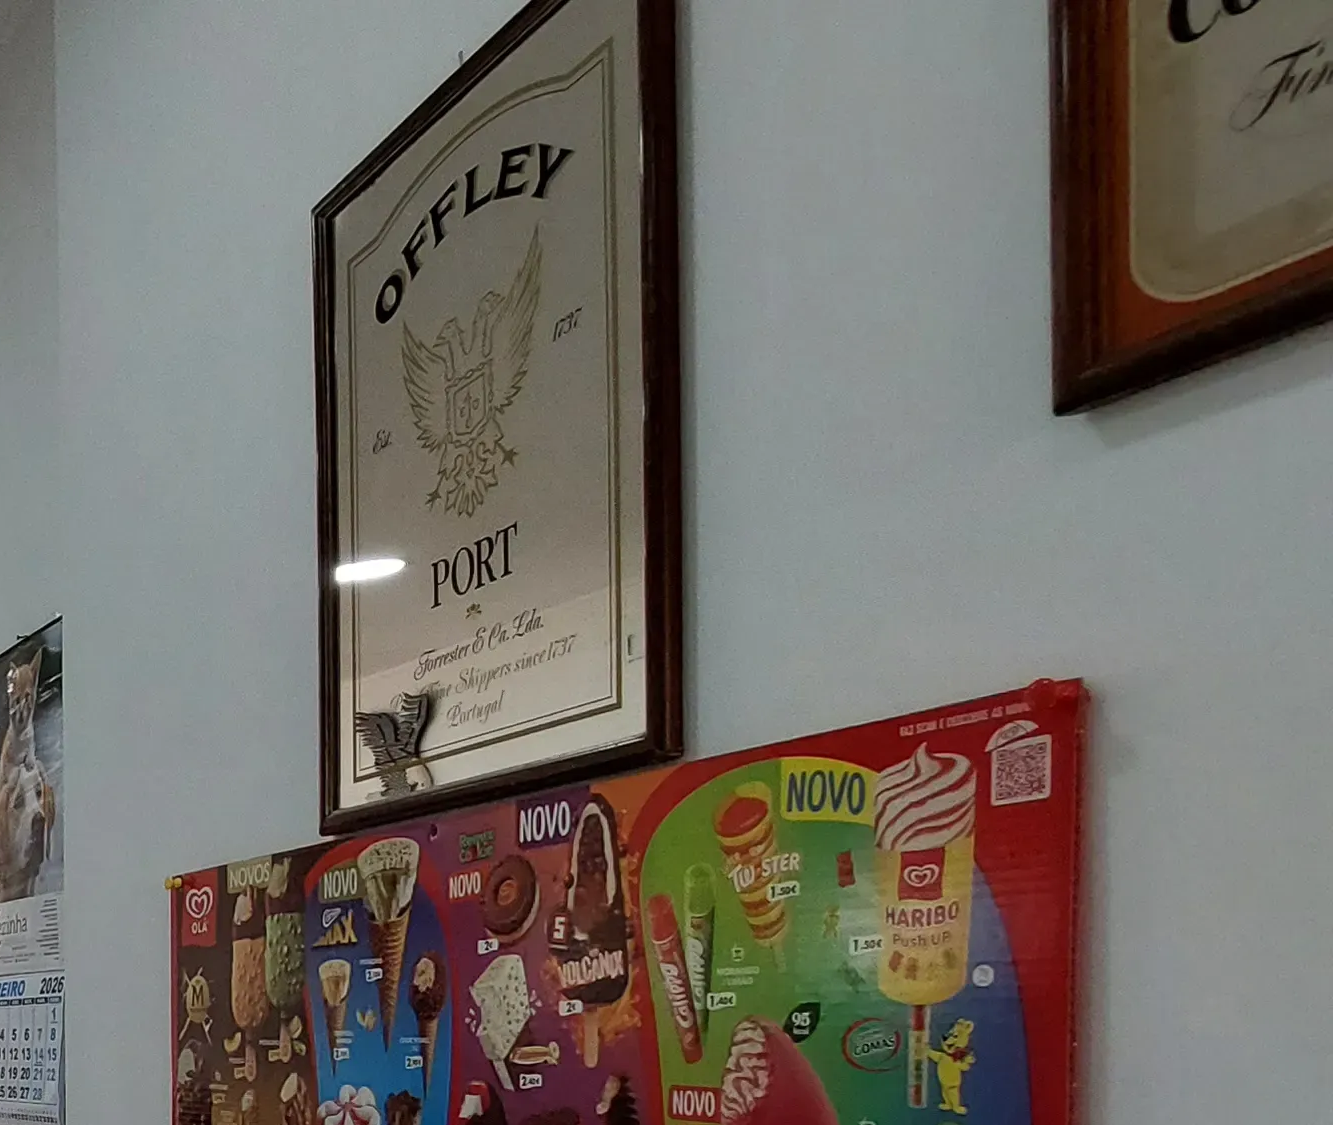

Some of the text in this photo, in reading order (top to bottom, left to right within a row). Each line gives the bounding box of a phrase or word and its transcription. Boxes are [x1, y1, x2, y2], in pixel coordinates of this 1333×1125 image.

[376, 143, 574, 325] OFFLEY
[552, 306, 583, 342] 1737
[431, 521, 518, 609] PORT
[413, 643, 471, 681] Forrester
[512, 608, 544, 638] Lda.
[455, 661, 512, 694] Shippers
[513, 650, 547, 673] since
[547, 634, 578, 662] 1737
[446, 689, 506, 729] Portugal
[786, 770, 866, 815] NOVO
[519, 801, 571, 843] NOVO
[228, 861, 271, 889] NOVOS
[323, 867, 358, 899] NOVO
[449, 871, 482, 899] NOVO
[885, 901, 961, 929] HARIBO
[892, 933, 927, 947] Push
[40, 976, 65, 994] 2026
[192, 984, 205, 1008] M
[791, 1012, 811, 1027] 95
[0, 1029, 4, 1041] 4
[12, 1029, 17, 1041] 5
[24, 1028, 29, 1041] 6
[38, 1029, 42, 1041] 7
[51, 1028, 56, 1041] 8
[10, 1048, 18, 1060] 12
[22, 1048, 31, 1060] 13
[35, 1048, 43, 1061] 14
[48, 1048, 56, 1060] 15
[9, 1067, 18, 1079] 19
[21, 1067, 30, 1080] 20
[8, 1086, 17, 1098] 26
[20, 1087, 29, 1099] 27
[671, 1090, 716, 1117] NOVO
